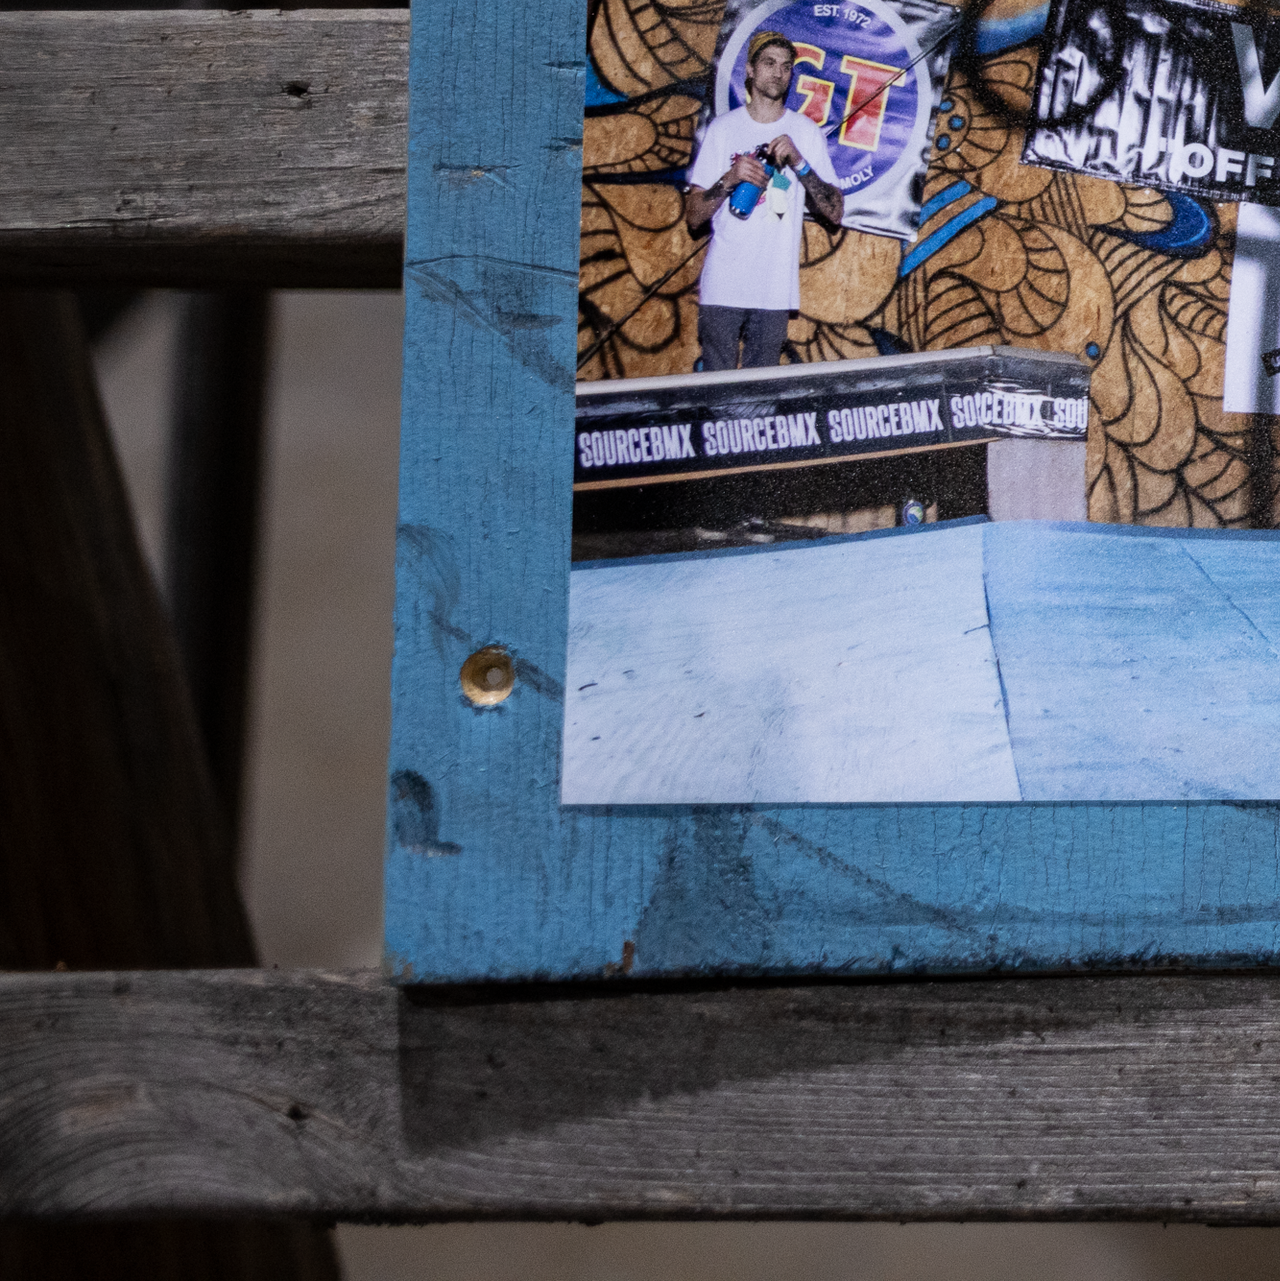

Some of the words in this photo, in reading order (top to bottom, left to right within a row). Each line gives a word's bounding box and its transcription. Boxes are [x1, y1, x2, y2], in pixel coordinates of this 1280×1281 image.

[814, 4, 840, 17] EST.
[843, 8, 871, 28] 1972
[579, 424, 696, 467] SOURCEBMX
[703, 412, 821, 456] SOURCEBMX
[829, 398, 944, 443] SOURCEBMX
